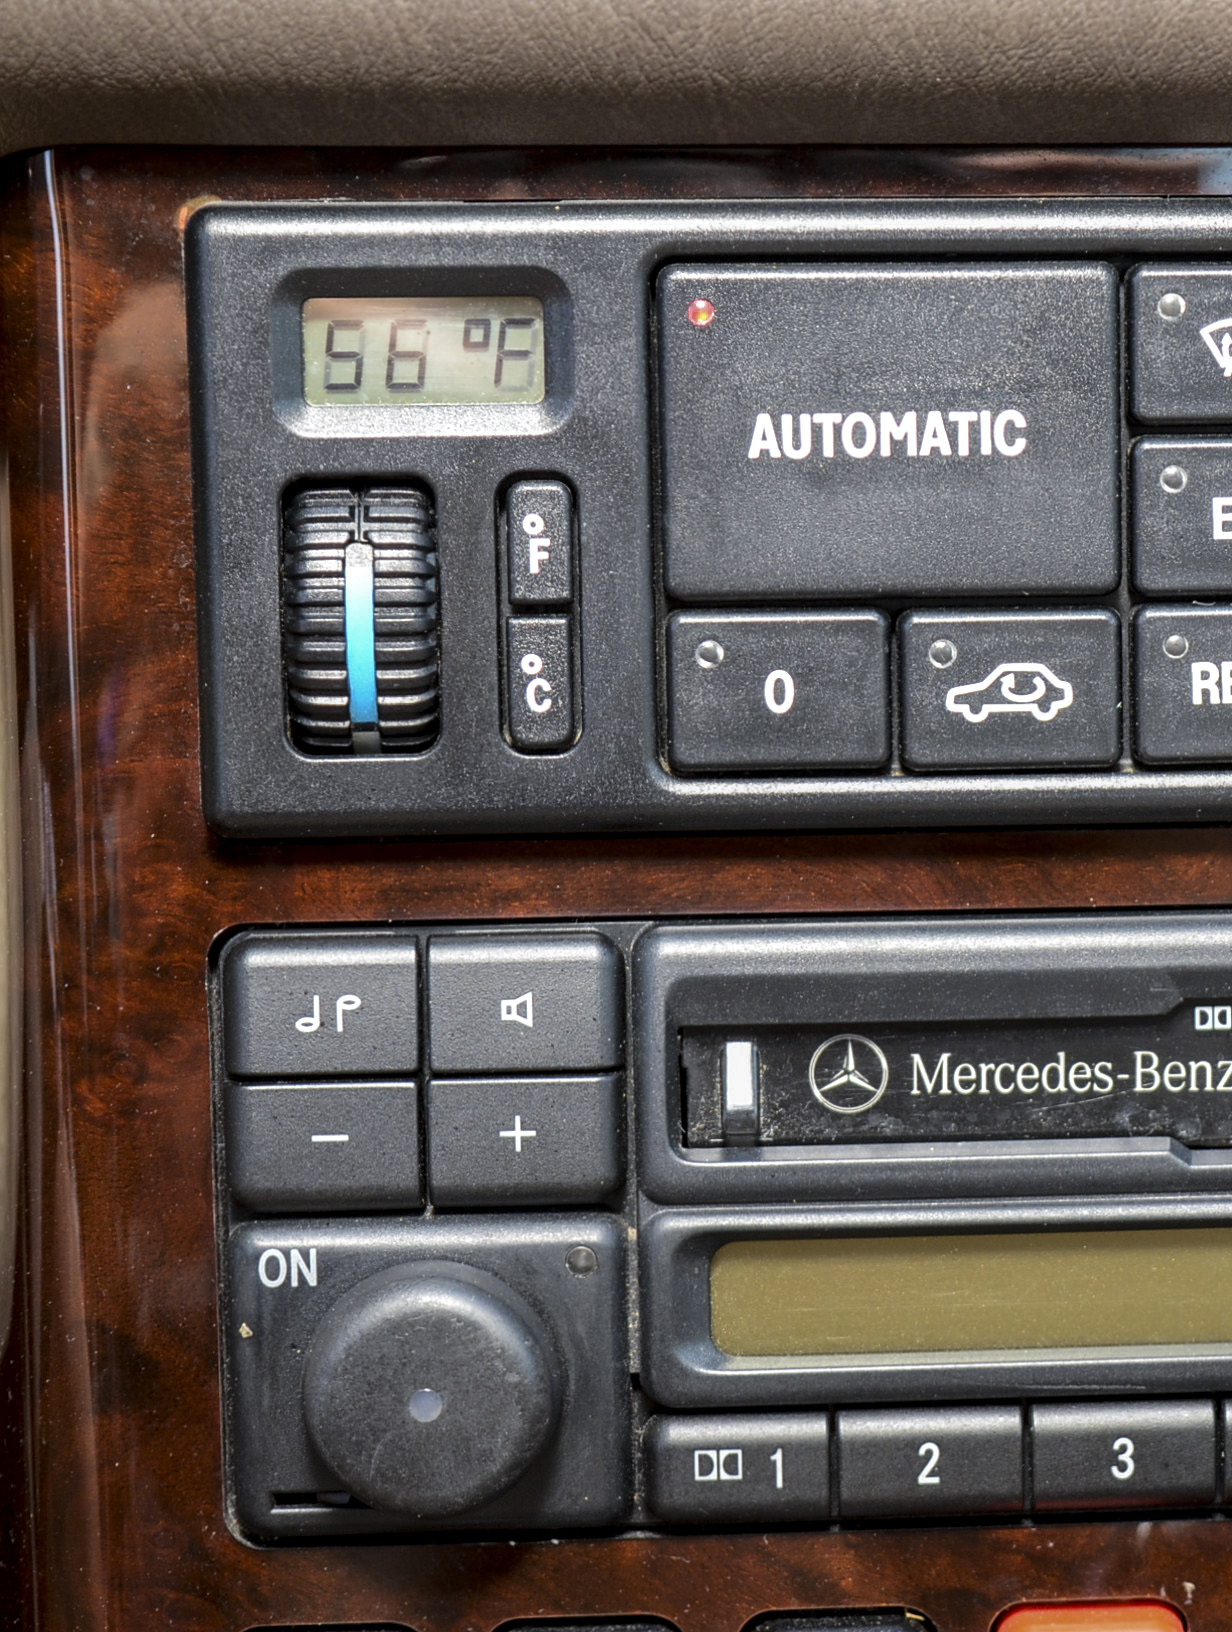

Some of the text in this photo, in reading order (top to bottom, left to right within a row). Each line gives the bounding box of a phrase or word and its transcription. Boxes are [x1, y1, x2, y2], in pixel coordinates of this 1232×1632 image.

[747, 409, 1029, 461] AUTOMATIC
[256, 1248, 319, 1288] ON
[769, 1447, 785, 1490] 1
[916, 1441, 942, 1486] 2
[1110, 1436, 1136, 1481] 3
